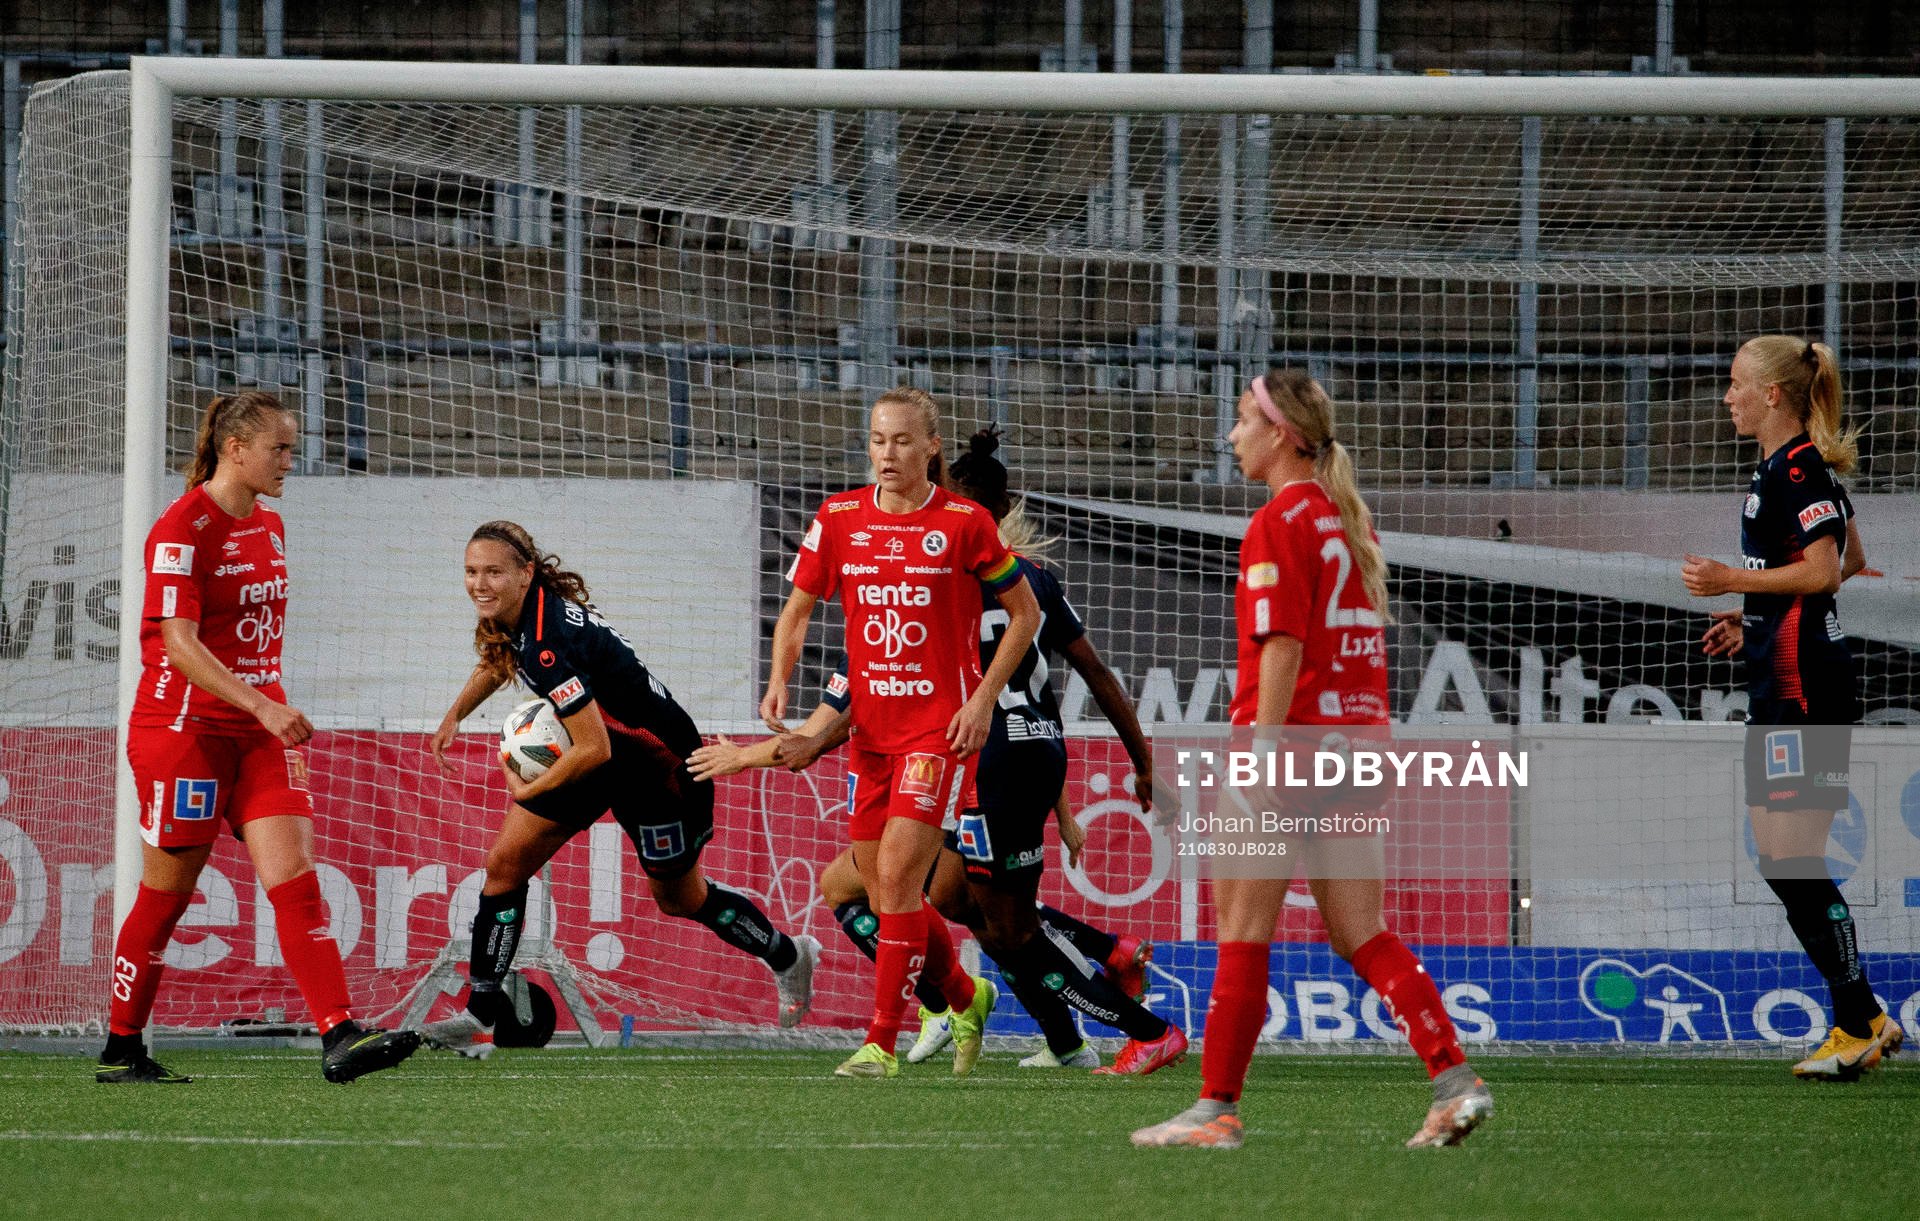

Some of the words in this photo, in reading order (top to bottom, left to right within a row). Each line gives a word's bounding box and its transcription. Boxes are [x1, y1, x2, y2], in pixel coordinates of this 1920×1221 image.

[850, 564, 879, 576] Epiroc
[857, 581, 931, 607] renta
[863, 608, 928, 659] ÖBO
[868, 661, 888, 672] Hem
[889, 662, 903, 672] för
[905, 662, 922, 673] dig
[1061, 985, 1120, 1023] LUNDBERGS
